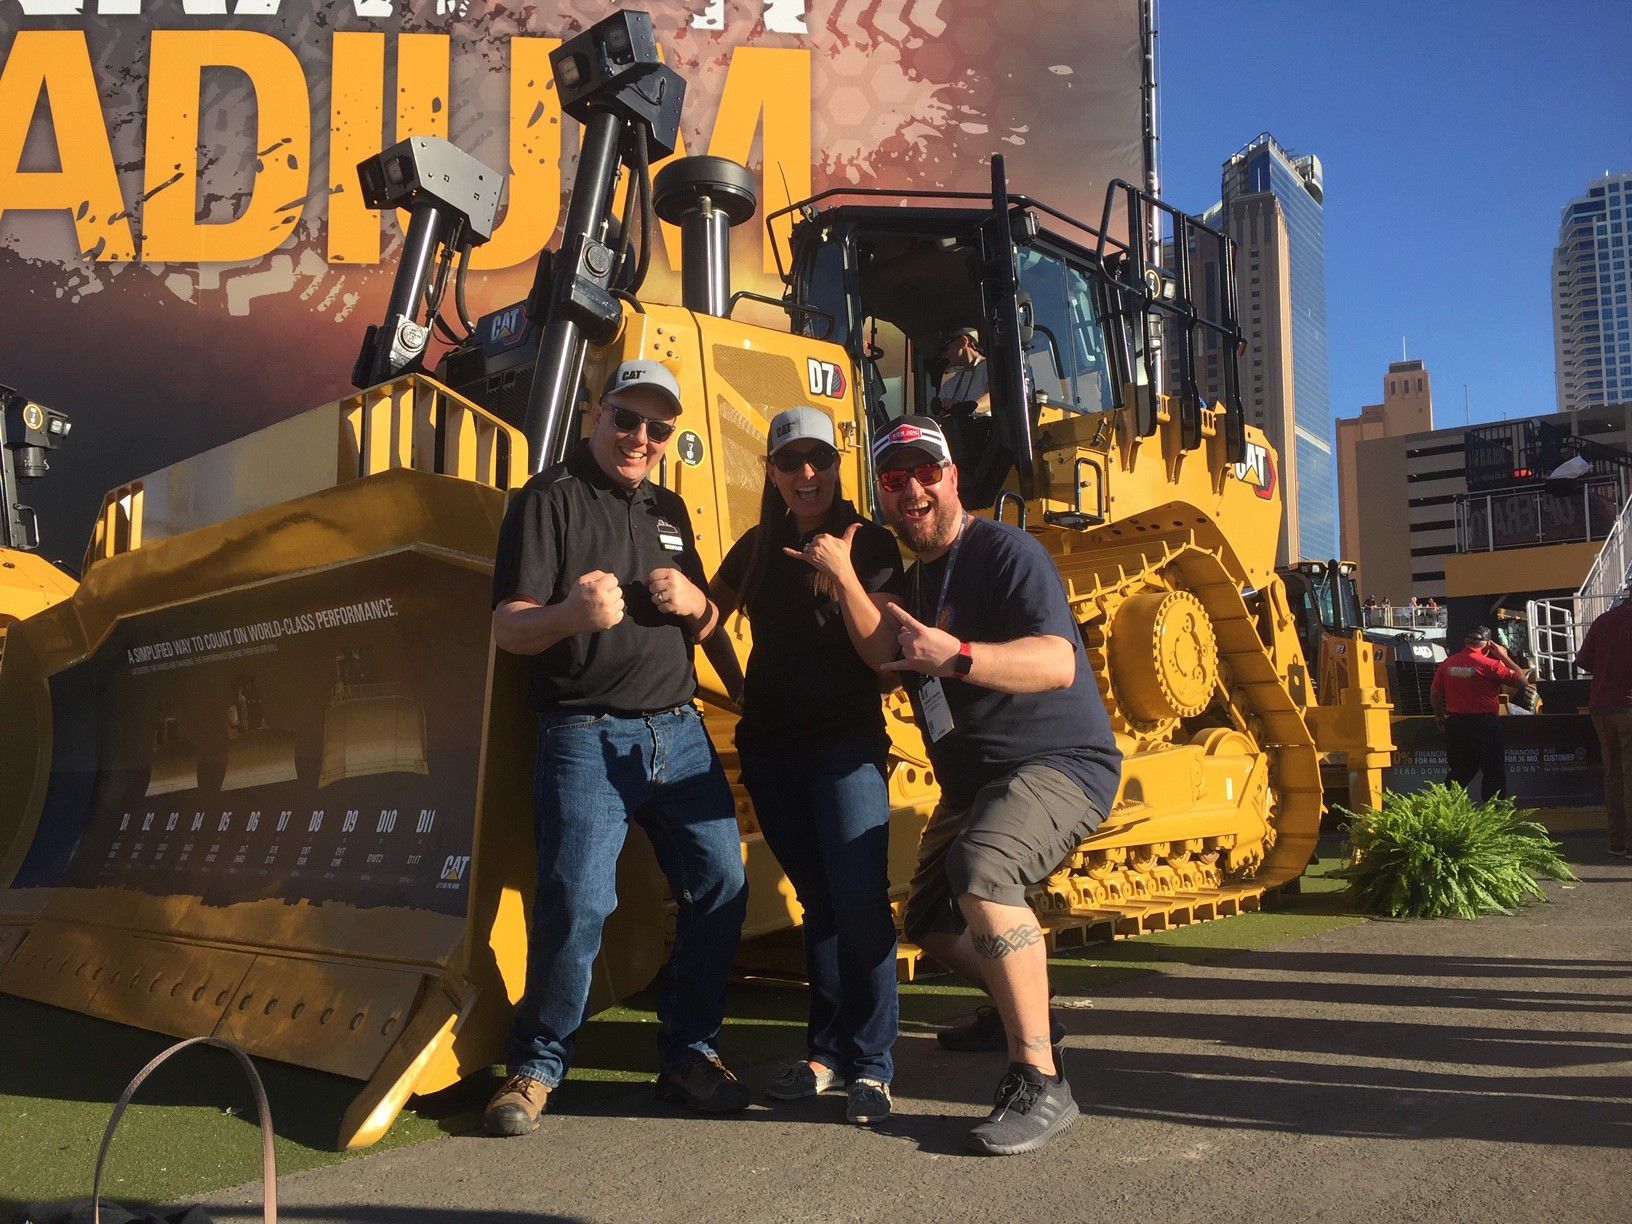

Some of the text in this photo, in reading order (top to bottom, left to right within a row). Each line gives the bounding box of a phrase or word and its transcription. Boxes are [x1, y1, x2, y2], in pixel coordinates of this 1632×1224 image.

[490, 308, 519, 341] CAT
[622, 370, 641, 381] CAT
[807, 358, 834, 396] D7
[127, 649, 135, 664] A
[133, 641, 174, 663] SIMPLIFIED
[172, 638, 192, 655] WAY
[191, 635, 204, 652] TO
[204, 629, 233, 650] COUNT
[233, 627, 248, 644] ON
[246, 613, 316, 642] WORLD-CLASS
[315, 597, 398, 629] PERFORMANCE.
[1543, 754, 1575, 762] CUSTOMER
[141, 812, 155, 831] D2
[165, 812, 179, 831] D3
[191, 812, 205, 831] D4
[217, 811, 232, 832] D5
[246, 811, 261, 832] D6
[276, 810, 292, 832] D7
[308, 810, 324, 832] D8
[342, 810, 358, 833] D9
[376, 809, 398, 833] D10
[416, 809, 437, 833] D11
[406, 855, 422, 865] D11T
[440, 855, 470, 880] CAT
